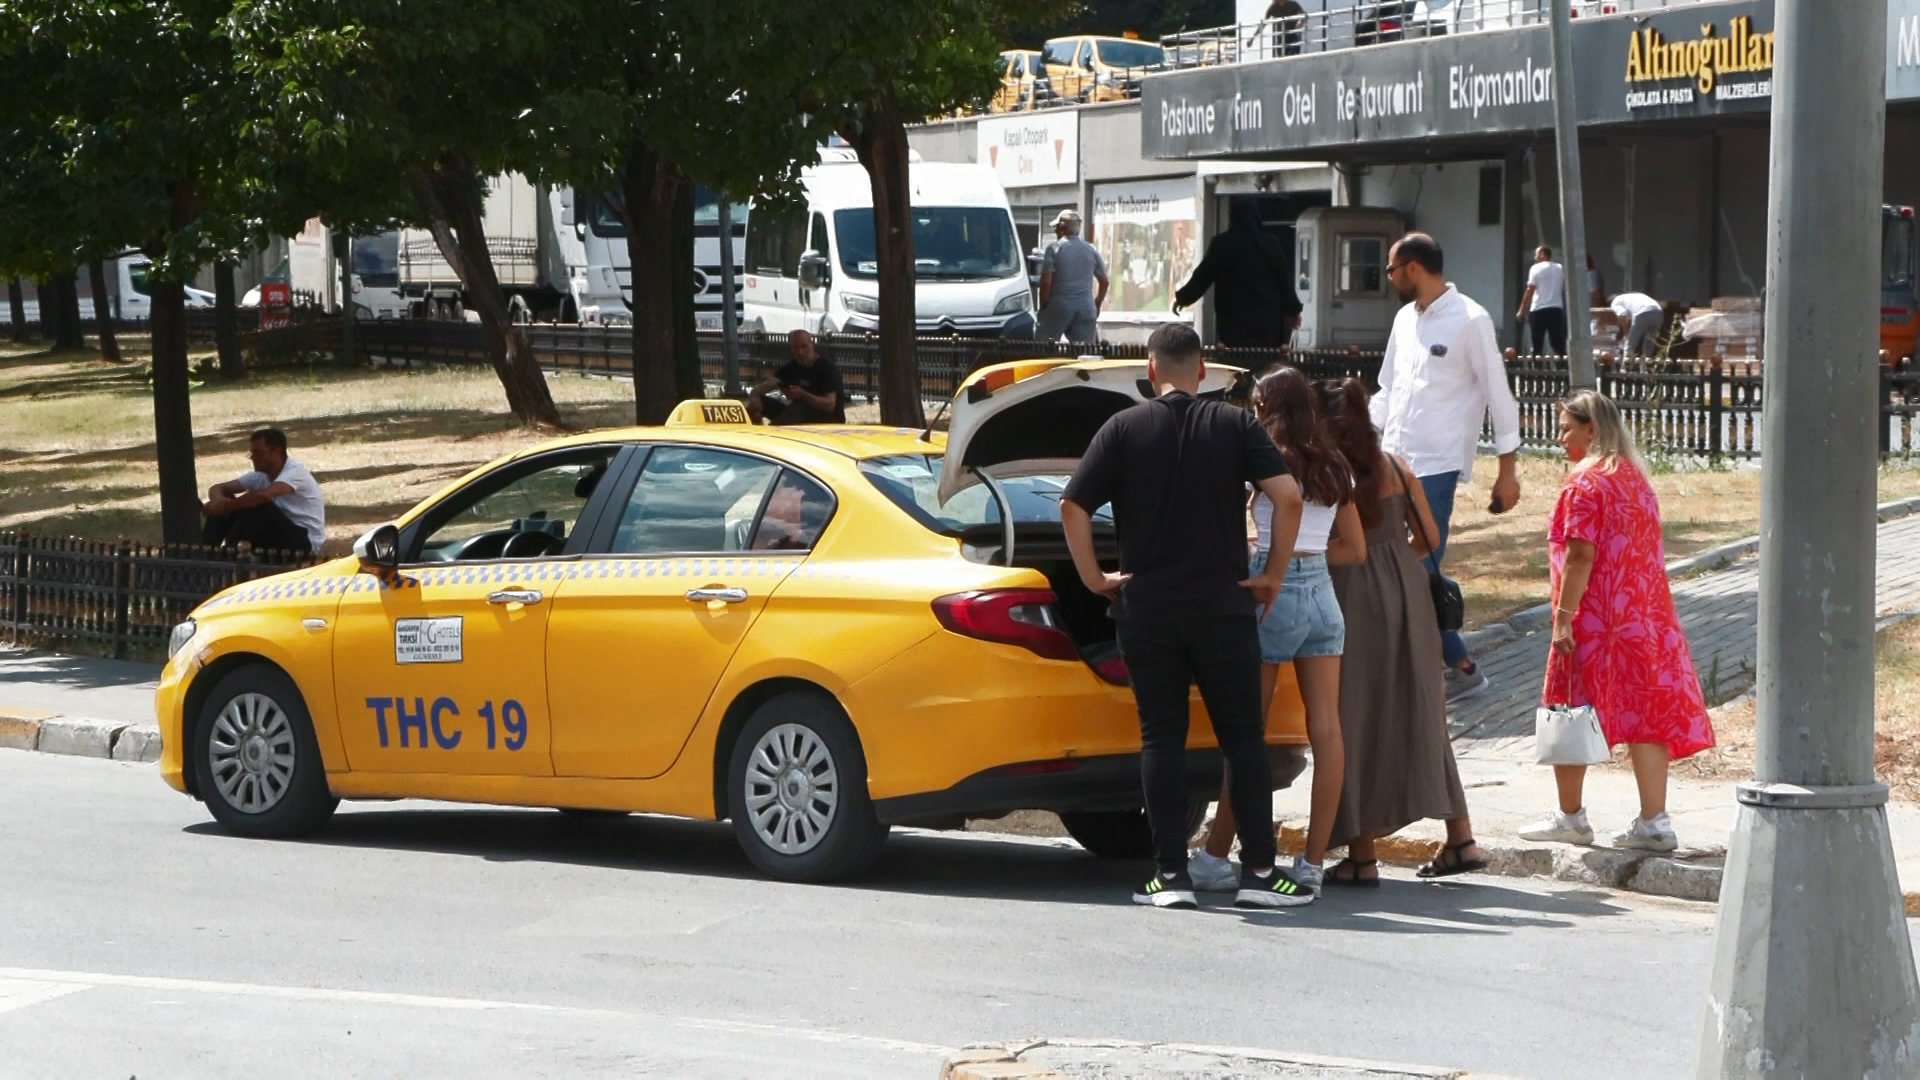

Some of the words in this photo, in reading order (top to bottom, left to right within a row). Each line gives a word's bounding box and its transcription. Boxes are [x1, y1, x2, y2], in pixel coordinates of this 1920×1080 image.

[1161, 97, 1215, 136] Pastane
[1234, 91, 1262, 130] Fırın
[1282, 82, 1316, 126] Otel
[1336, 70, 1424, 120] Retaurant
[1449, 57, 1554, 119] Ekipmanlar
[1669, 87, 1694, 104] PASTA
[704, 406, 744, 422] TAKSİ
[365, 697, 462, 750] THC
[478, 699, 528, 751] 19
